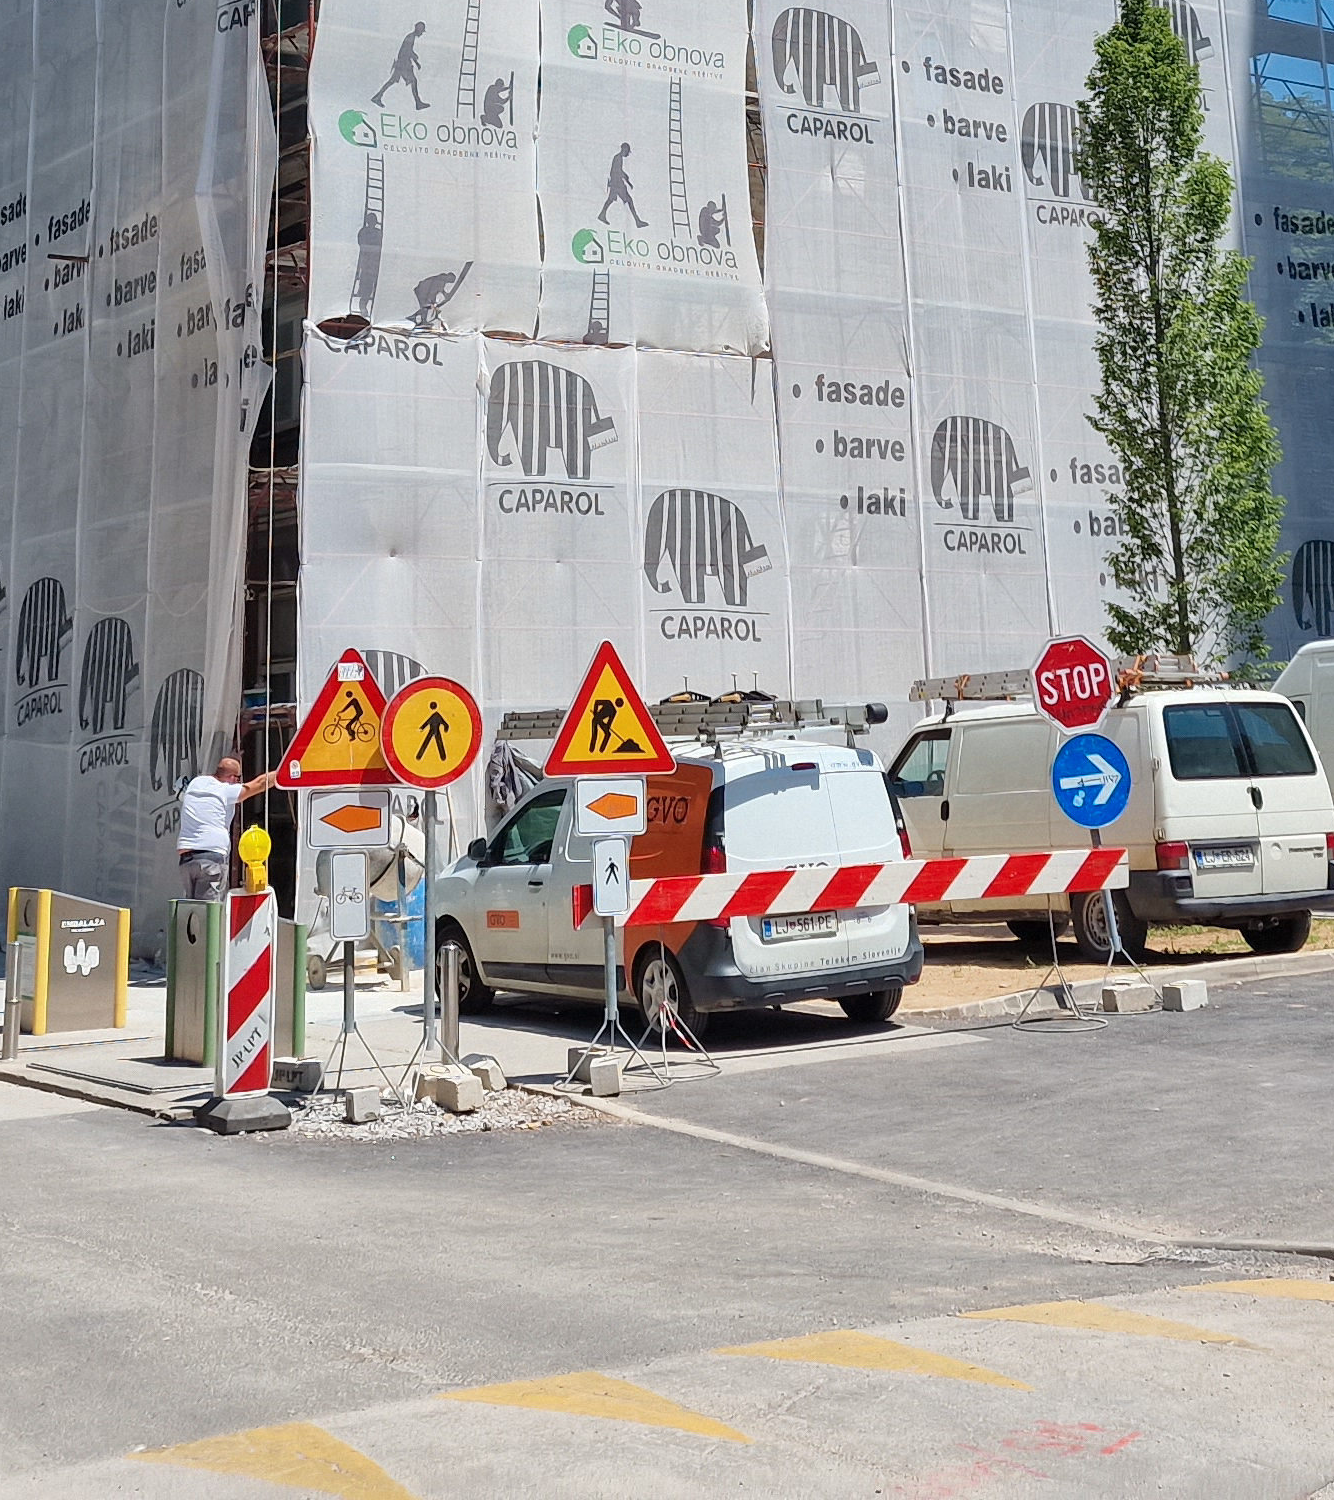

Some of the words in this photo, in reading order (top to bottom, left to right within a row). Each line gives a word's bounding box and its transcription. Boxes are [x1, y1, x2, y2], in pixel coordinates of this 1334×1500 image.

[602, 28, 642, 55] Eko
[649, 38, 726, 69] obnova
[922, 57, 1004, 95] fasade
[380, 113, 428, 141] Eko
[436, 119, 519, 149] obnova
[786, 112, 875, 145] CAPAROL
[943, 108, 1009, 143] barve
[967, 162, 1013, 193] laki
[109, 212, 158, 257] fasade
[607, 229, 650, 257] Eko
[657, 238, 739, 269] obnova
[180, 247, 206, 282] fasa
[114, 270, 157, 306] barve
[127, 318, 156, 358] laki
[814, 374, 905, 408] fasade
[833, 431, 905, 462] barve
[1069, 456, 1124, 485] fasa
[498, 489, 605, 516] CAPAROL
[856, 486, 907, 518] laki
[943, 529, 1027, 555] CAPAROL
[660, 616, 762, 643] CAPAROL
[1040, 662, 1106, 705] STOP
[16, 690, 64, 727] CAPAROL
[79, 741, 130, 774] CAPAROL
[646, 796, 689, 825] GVO
[774, 920, 789, 935] LJ
[774, 959, 815, 973] Skupine
[819, 954, 858, 967] Telekom
[862, 946, 902, 960] Slovenije
